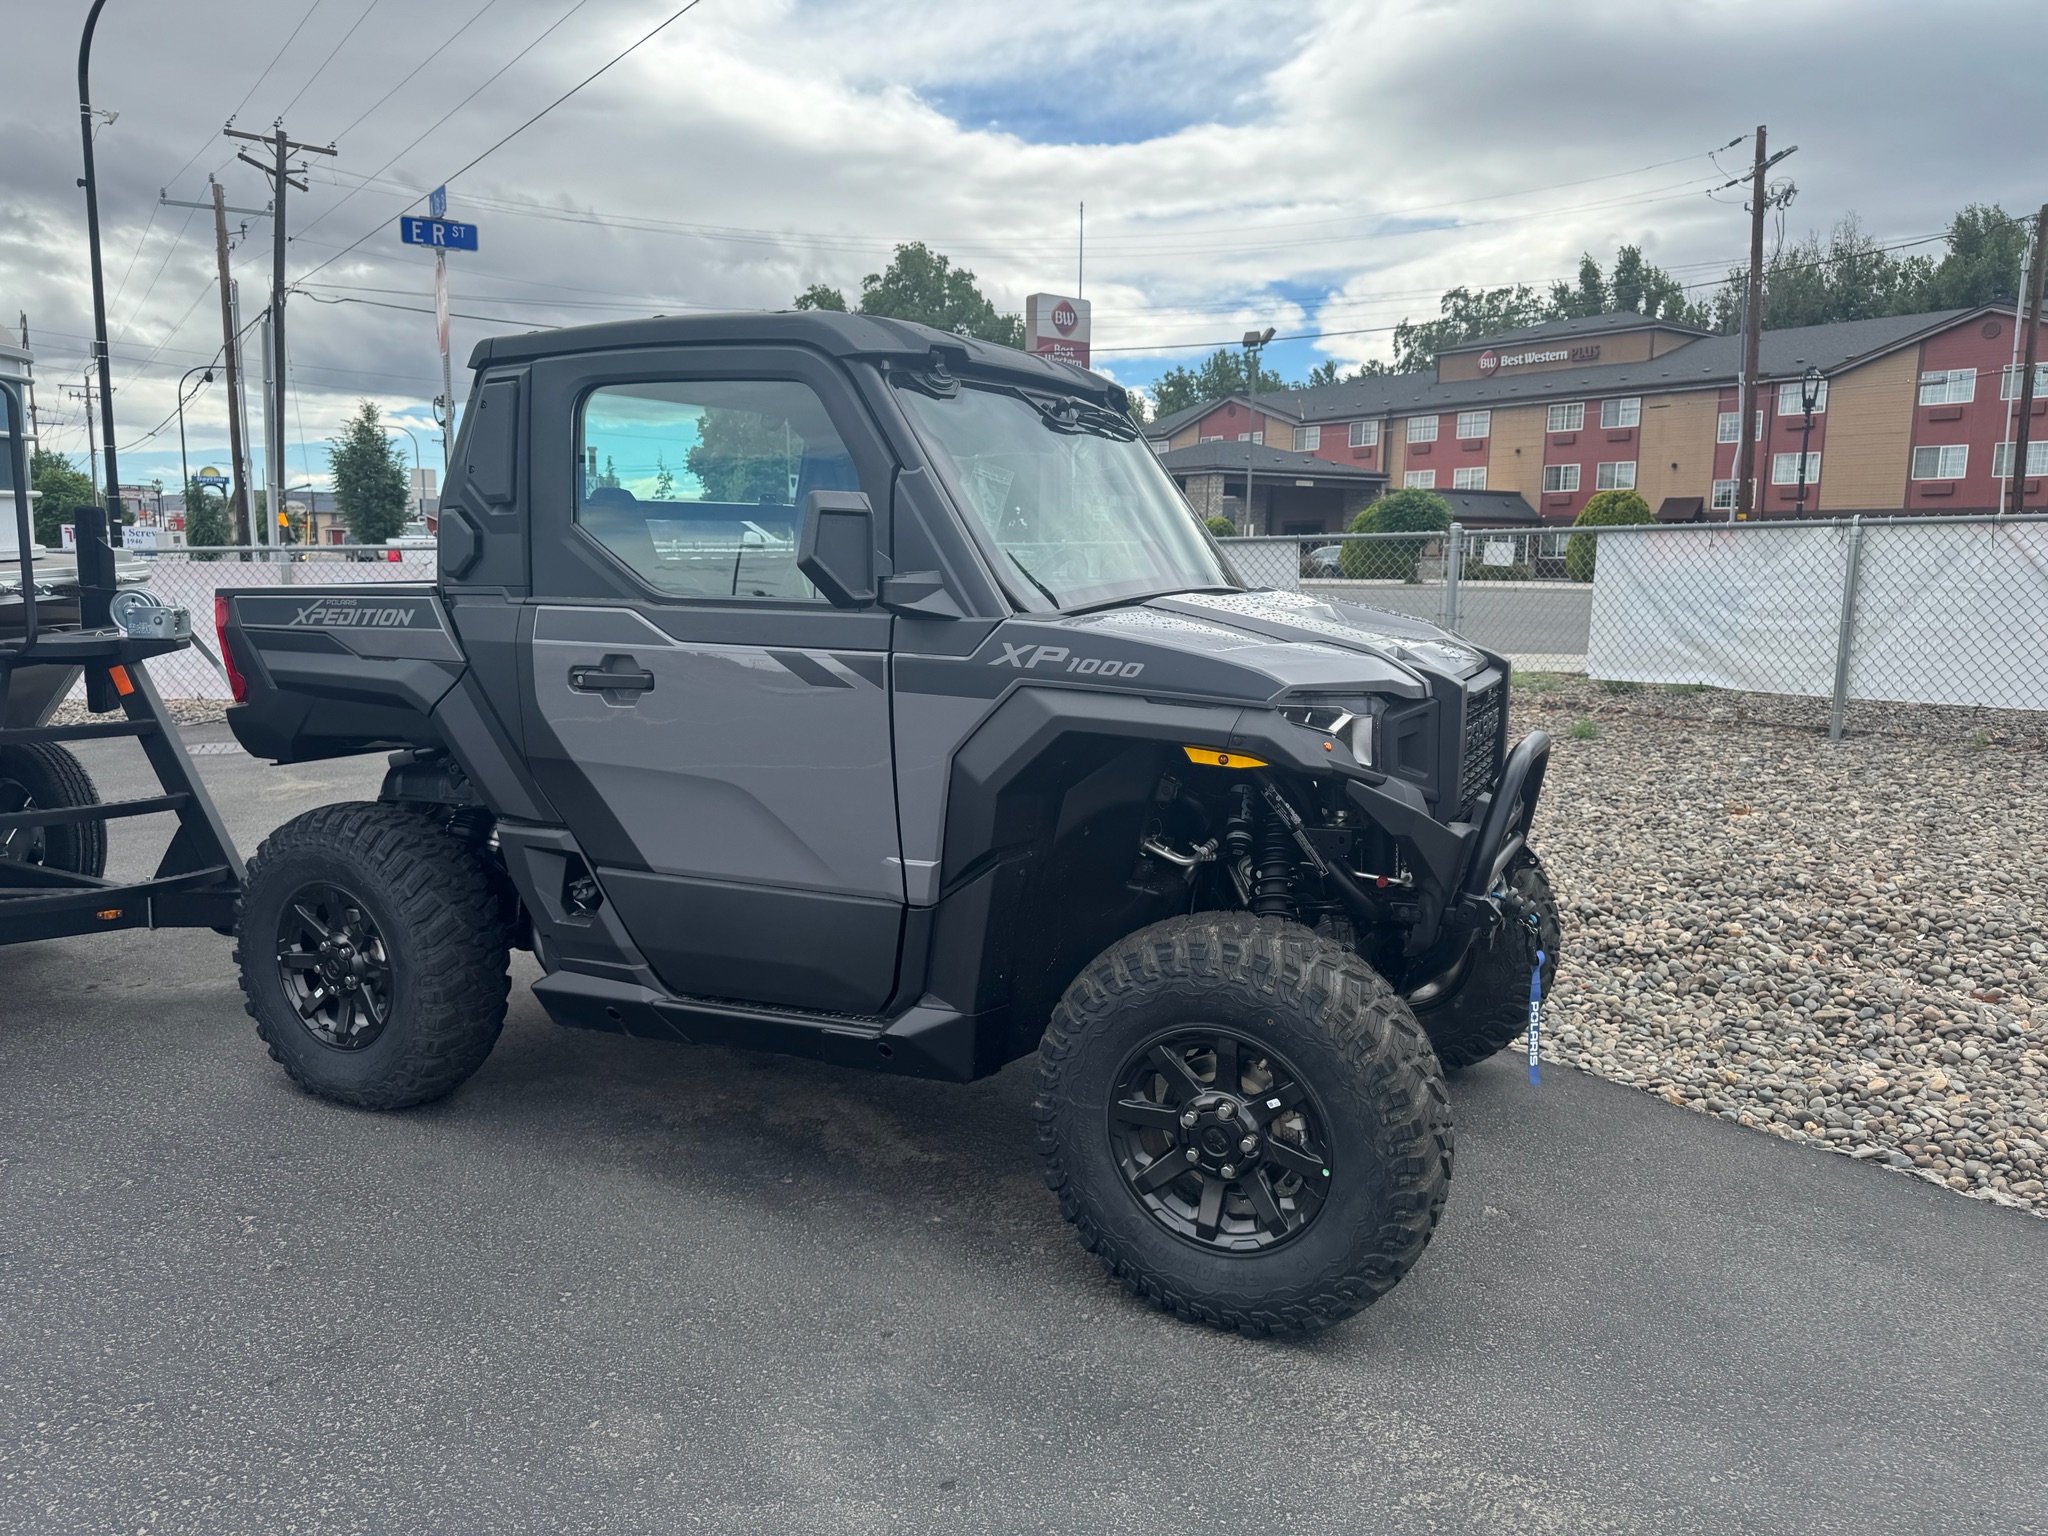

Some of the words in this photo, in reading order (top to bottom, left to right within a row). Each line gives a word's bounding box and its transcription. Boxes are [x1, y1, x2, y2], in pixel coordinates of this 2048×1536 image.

[412, 220, 424, 242] E
[432, 223, 446, 245] R
[452, 226, 466, 239] ST
[1055, 310, 1075, 325] BW
[1054, 344, 1075, 357] Best
[1480, 357, 1497, 369] BW
[1500, 355, 1523, 367] Best
[1524, 350, 1568, 364] Western
[1571, 345, 1601, 358] PLUS
[127, 537, 143, 545] 1946
[289, 599, 416, 627] XPEDITION
[326, 598, 358, 606] POLARIS
[987, 642, 1070, 669] XP
[1066, 657, 1145, 678] 1000
[1529, 1001, 1539, 1066] POLARIS
